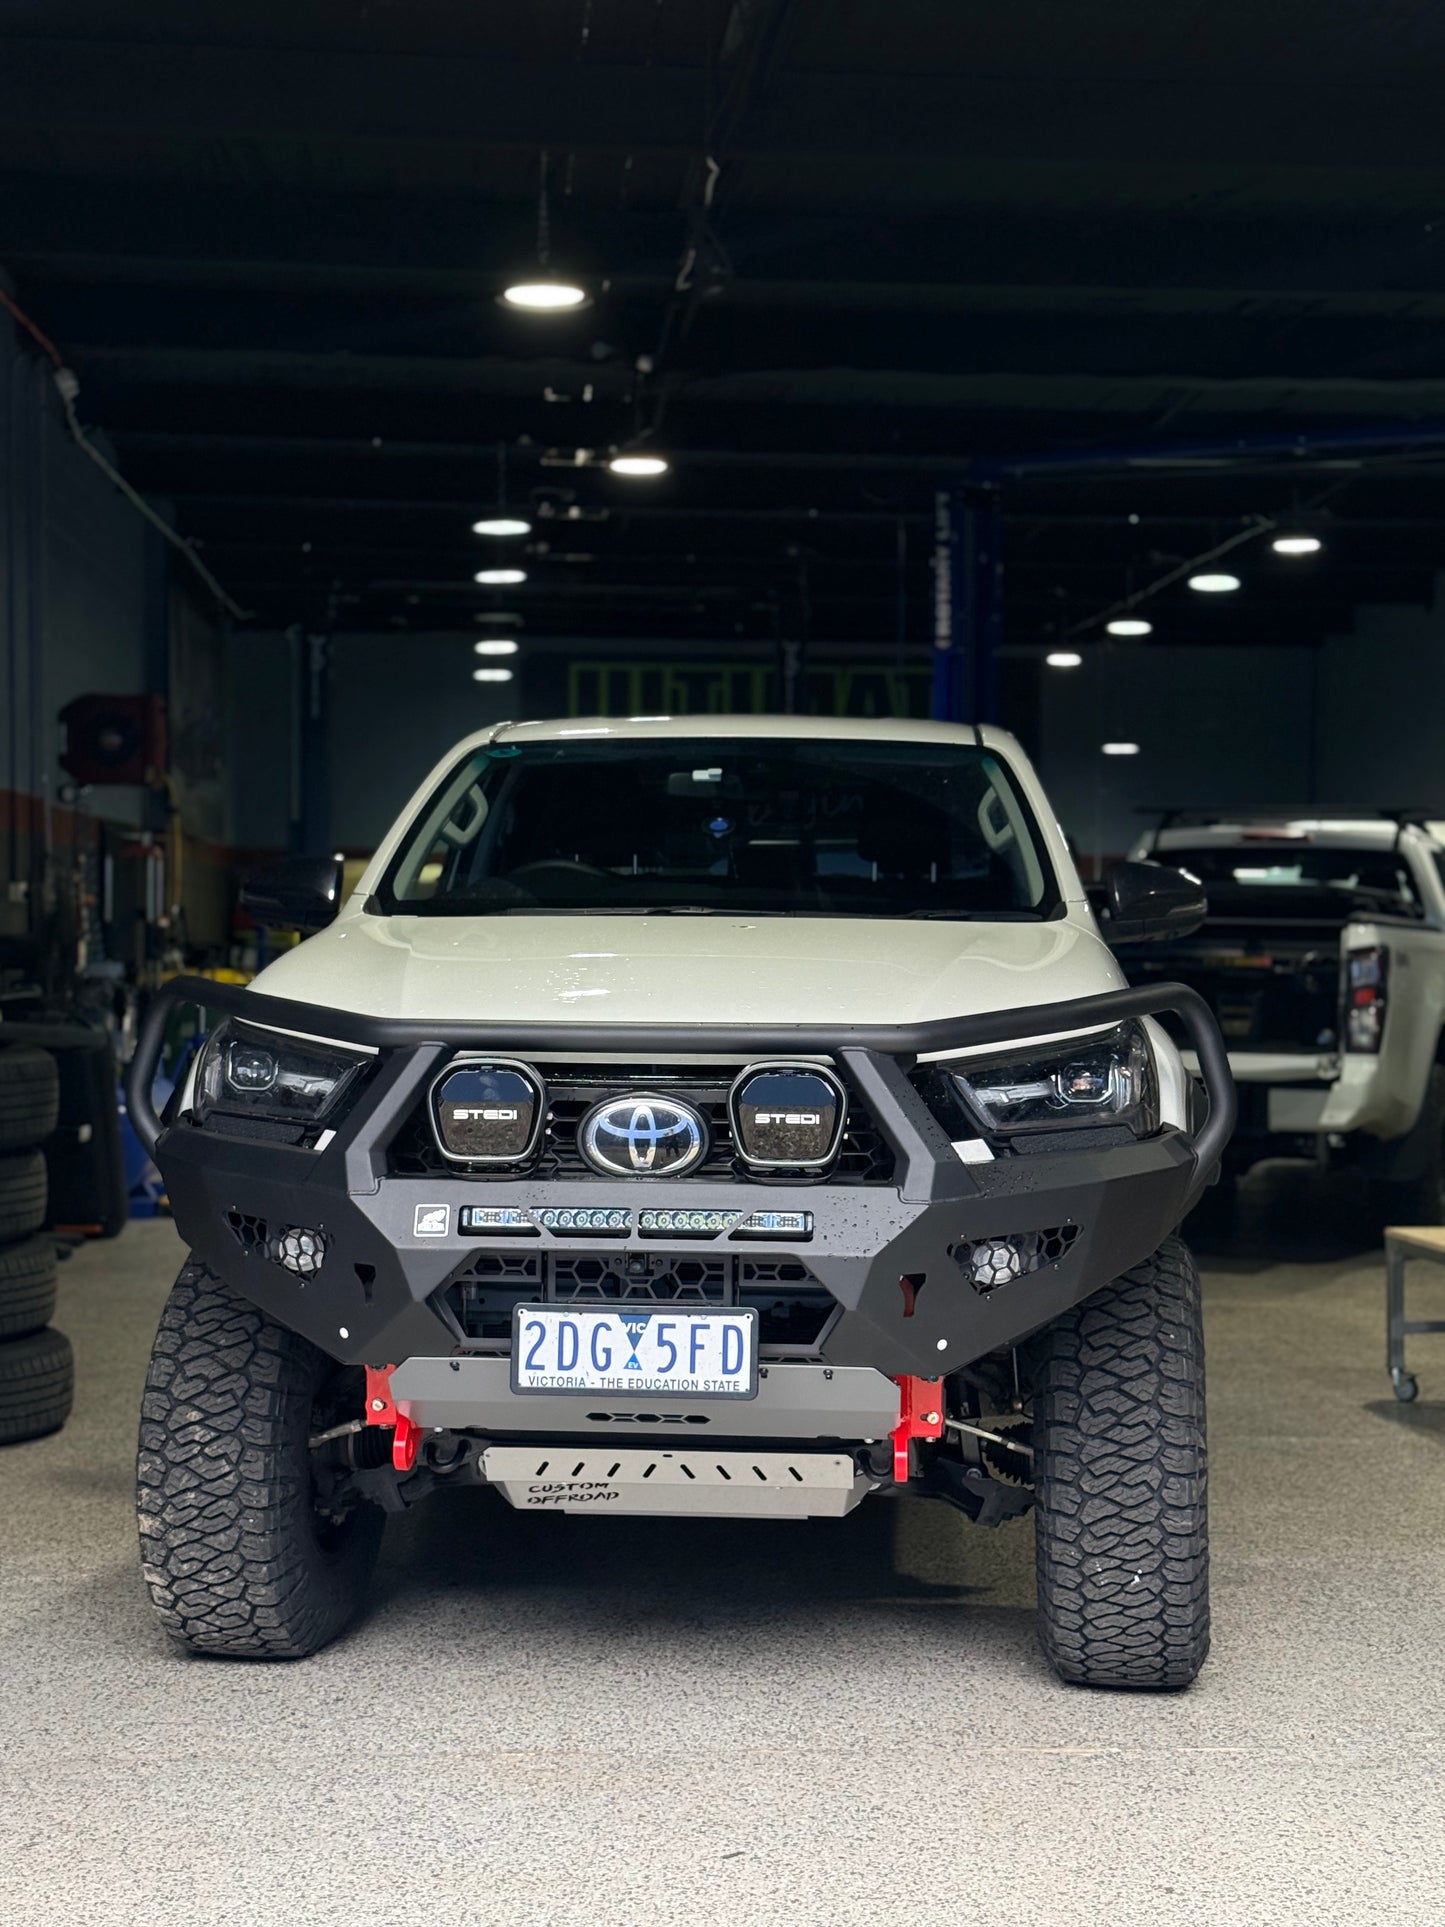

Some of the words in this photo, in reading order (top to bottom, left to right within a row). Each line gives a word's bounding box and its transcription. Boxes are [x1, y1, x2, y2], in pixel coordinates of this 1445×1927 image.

[453, 1109, 518, 1120] STEDI
[755, 1113, 820, 1125] STEDI
[623, 1322, 647, 1334] VIC
[525, 1320, 612, 1372] 2DG
[657, 1323, 744, 1375] 5FD
[528, 1376, 586, 1388] VICTORIA
[600, 1378, 623, 1389] THE
[628, 1379, 698, 1391] EDUCATION
[703, 1381, 740, 1391] STATE
[529, 1482, 609, 1493] CUSTOM
[528, 1492, 619, 1504] OFFROAD
